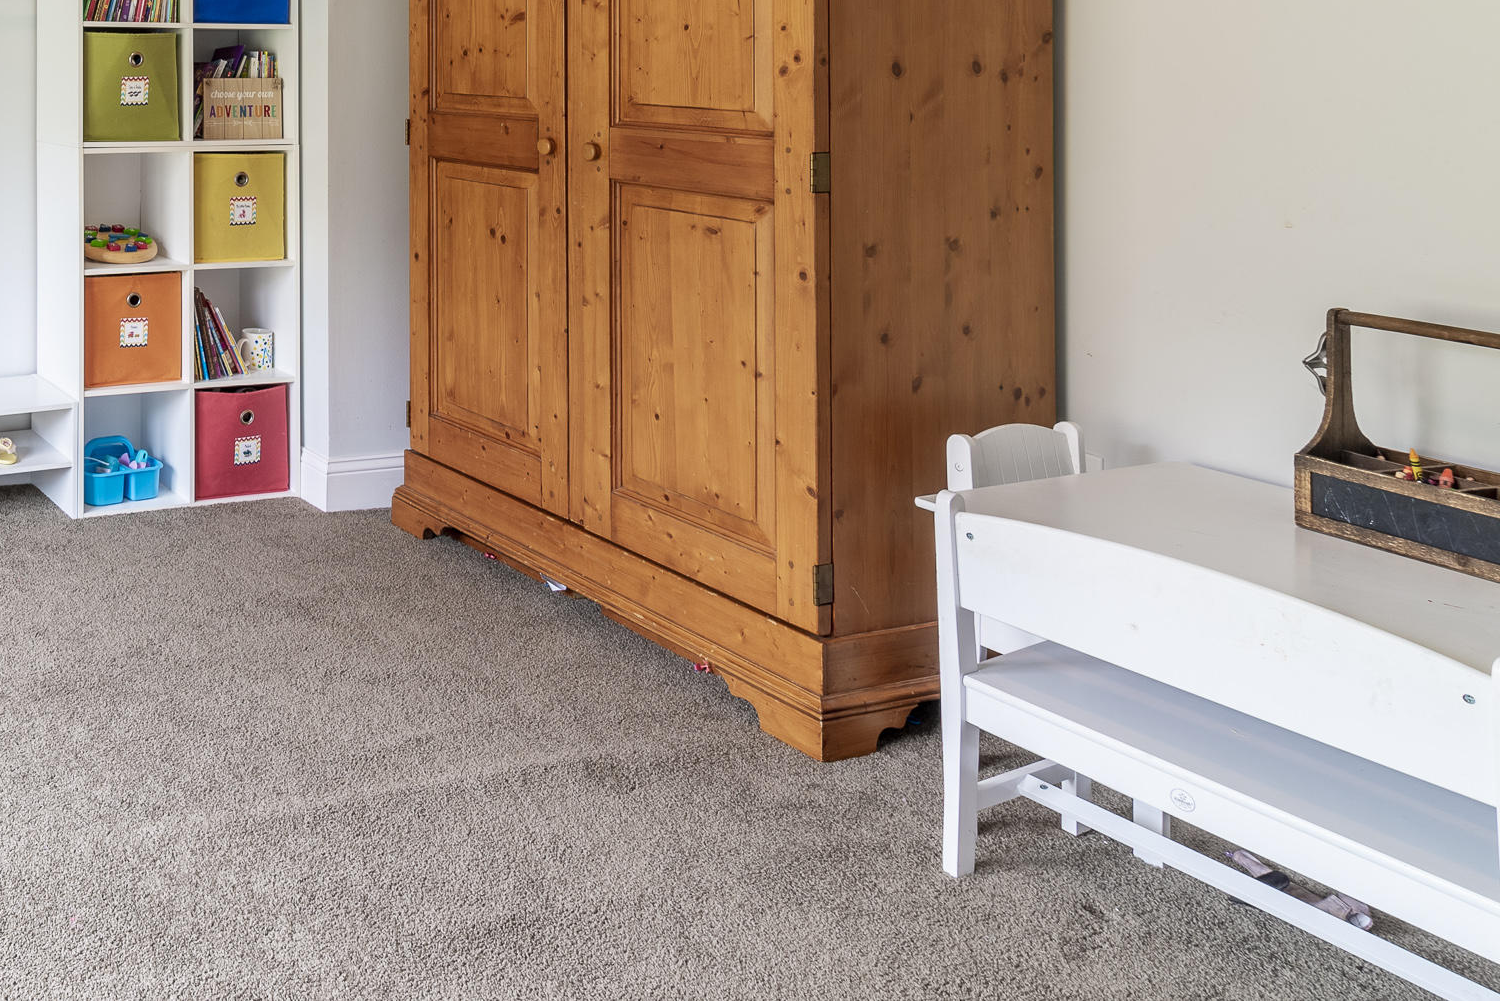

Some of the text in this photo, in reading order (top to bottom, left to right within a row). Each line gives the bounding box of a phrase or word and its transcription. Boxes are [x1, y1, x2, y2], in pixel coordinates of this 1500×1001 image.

[210, 89, 274, 101] choose your own
[209, 104, 276, 118] ADVENTURE
